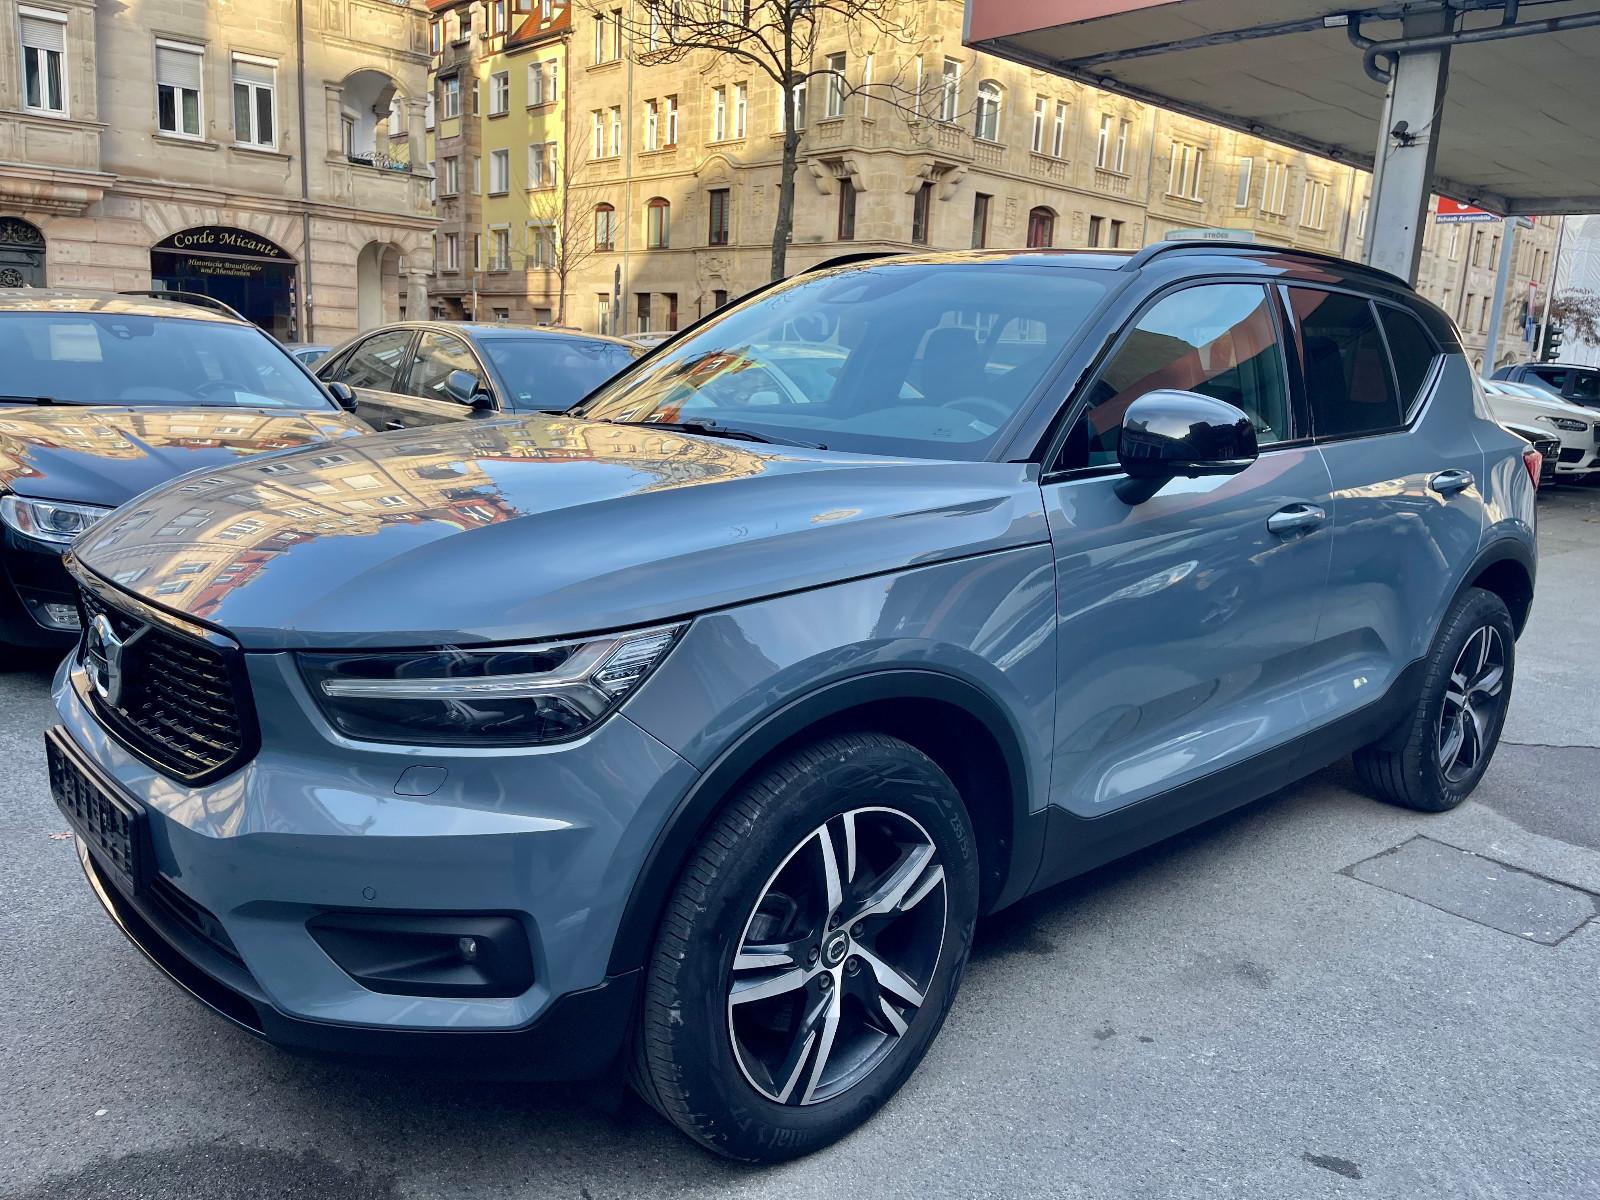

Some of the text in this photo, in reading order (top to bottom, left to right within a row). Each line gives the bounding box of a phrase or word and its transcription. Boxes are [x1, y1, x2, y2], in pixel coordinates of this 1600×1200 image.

[174, 230, 279, 257] Corde Micante
[188, 259, 223, 268] Historische
